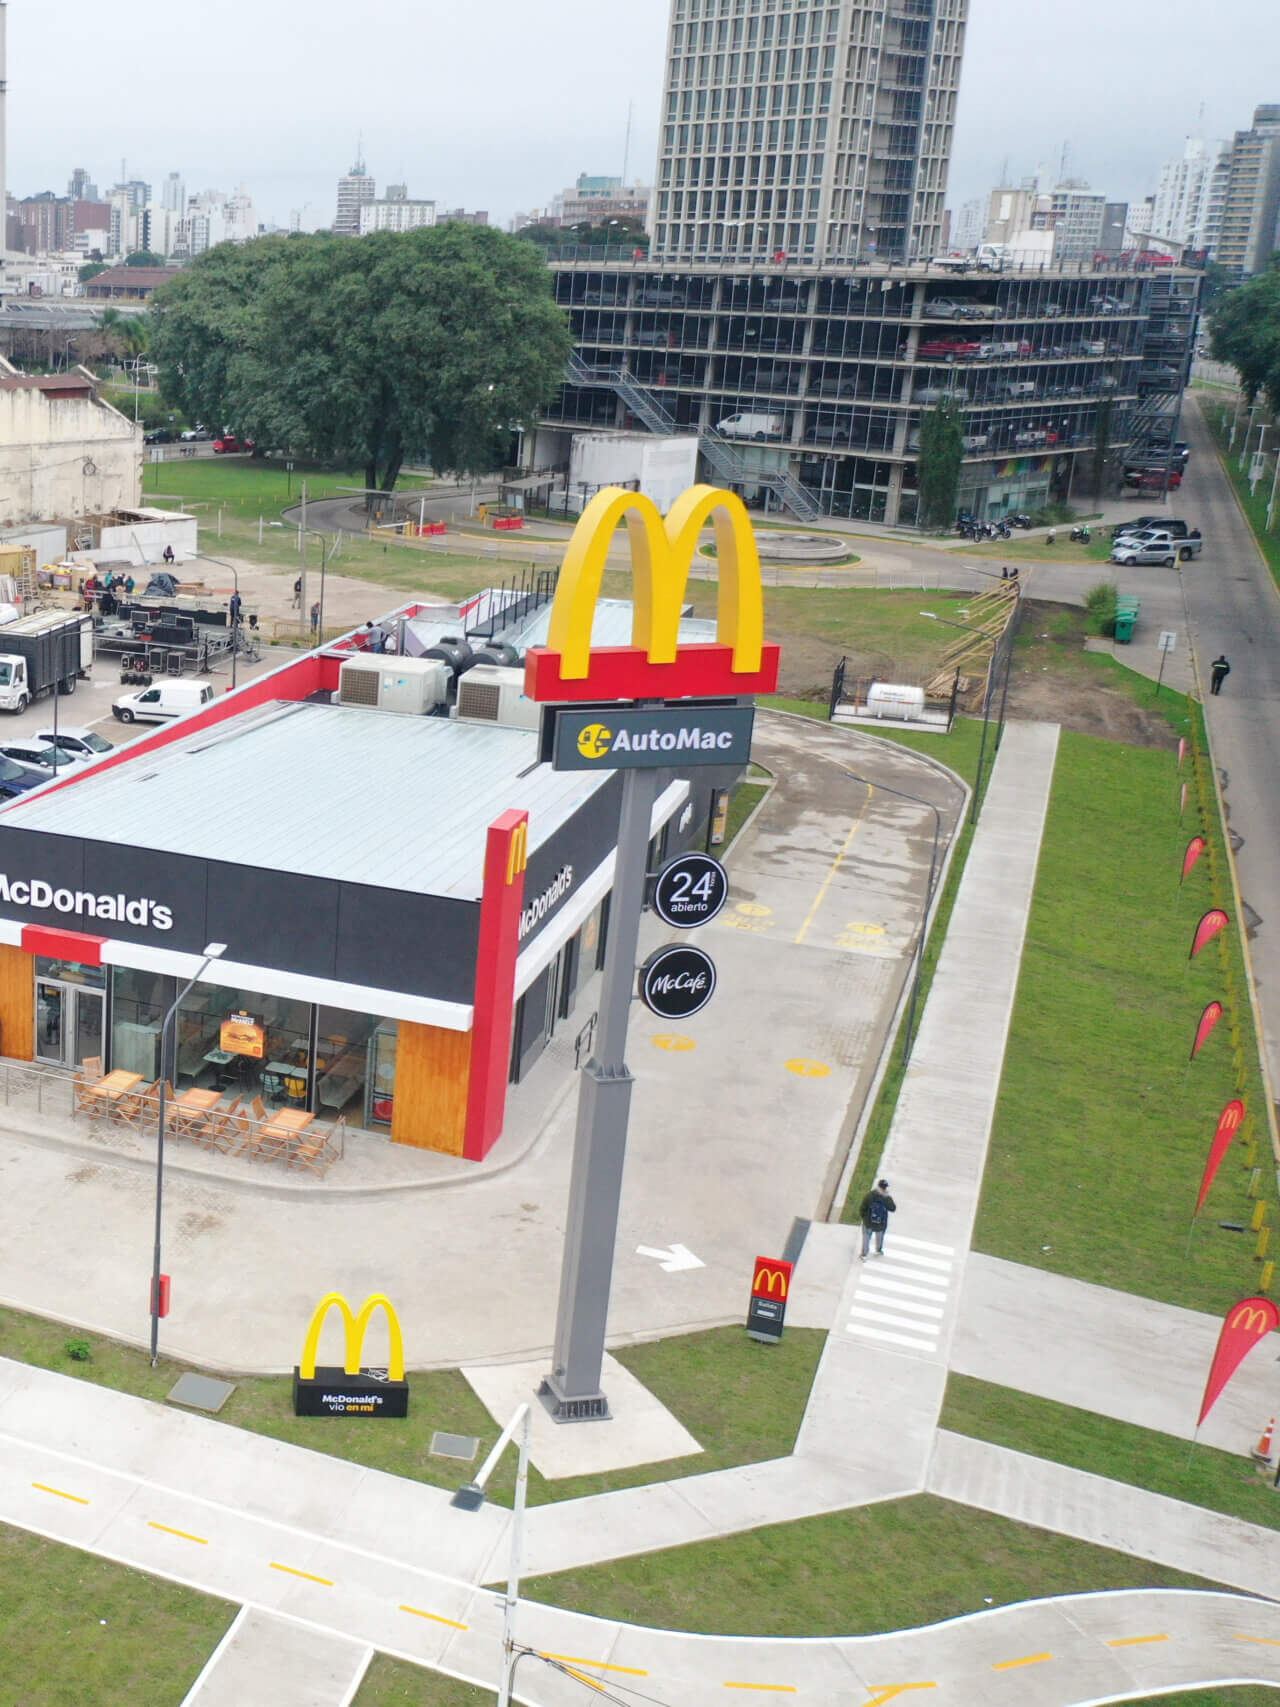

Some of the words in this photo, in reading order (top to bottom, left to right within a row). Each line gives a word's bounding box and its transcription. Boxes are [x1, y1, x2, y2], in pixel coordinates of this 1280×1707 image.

[612, 727, 733, 752] AutoMac
[670, 871, 712, 902] 24
[670, 901, 709, 912] abierto
[651, 971, 707, 995] McCafé
[322, 1395, 383, 1404] McDonald's
